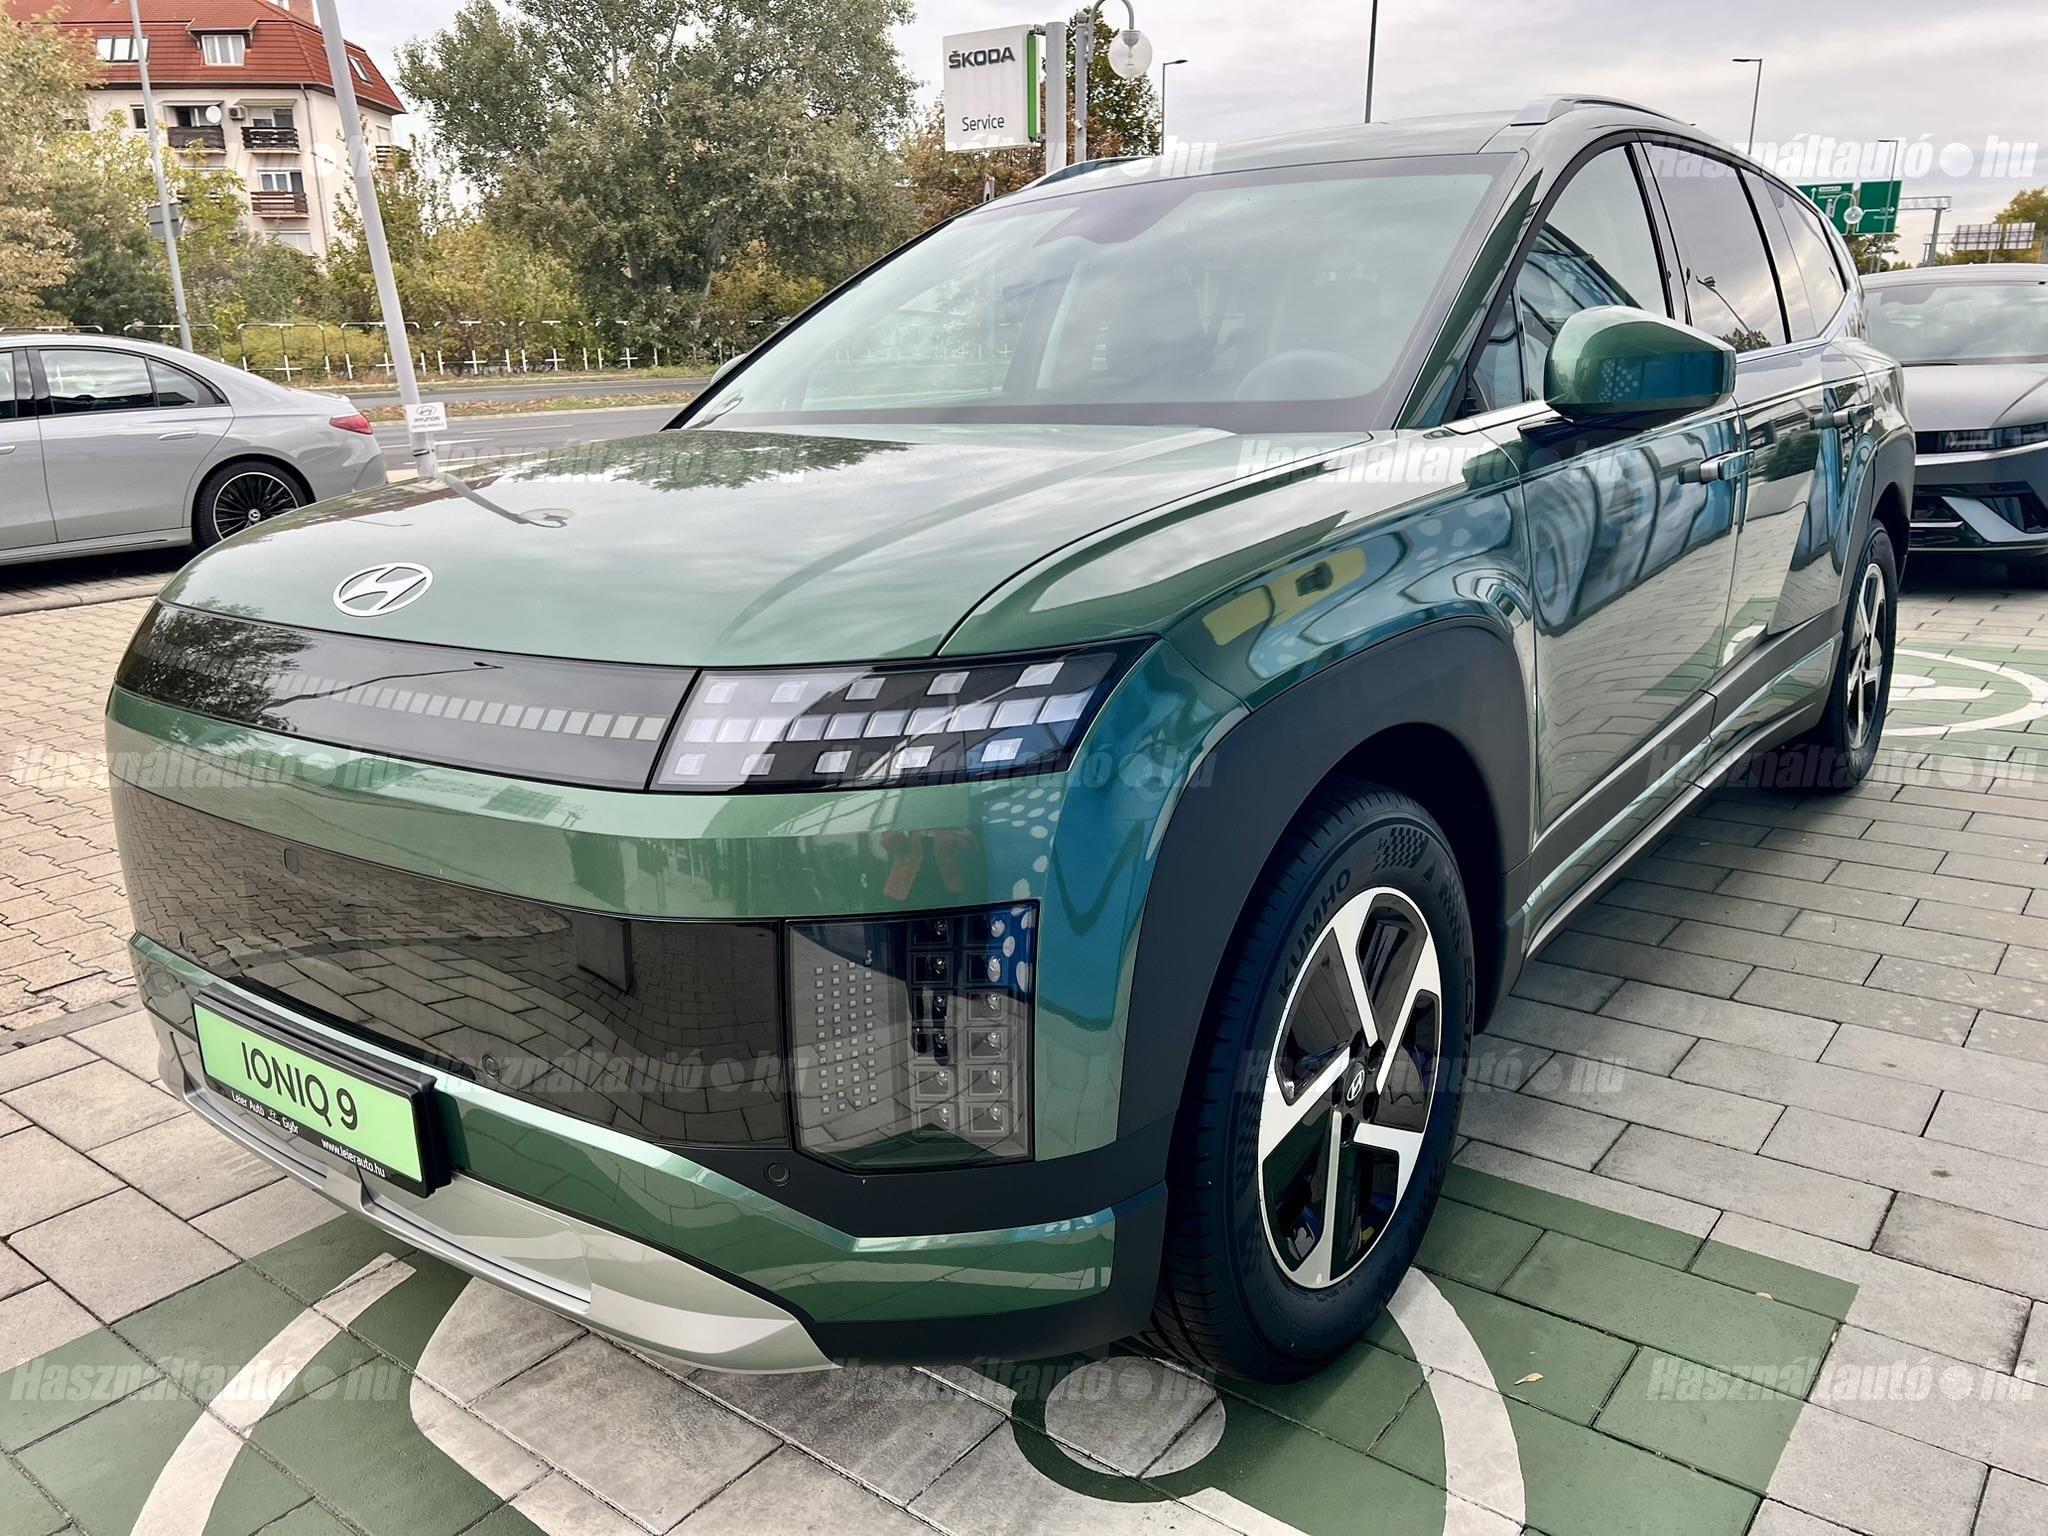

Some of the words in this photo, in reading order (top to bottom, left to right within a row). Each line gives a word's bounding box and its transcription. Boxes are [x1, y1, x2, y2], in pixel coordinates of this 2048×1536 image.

[948, 46, 1016, 69] ŠKODA
[961, 114, 1005, 131] Service
[1277, 868, 1351, 998] KUMHO
[241, 1041, 332, 1127] IONIQ
[336, 1087, 358, 1131] 9
[231, 1091, 248, 1108] Leier
[249, 1099, 265, 1116] Auto
[321, 1138, 386, 1178] www.leierauto.hu
